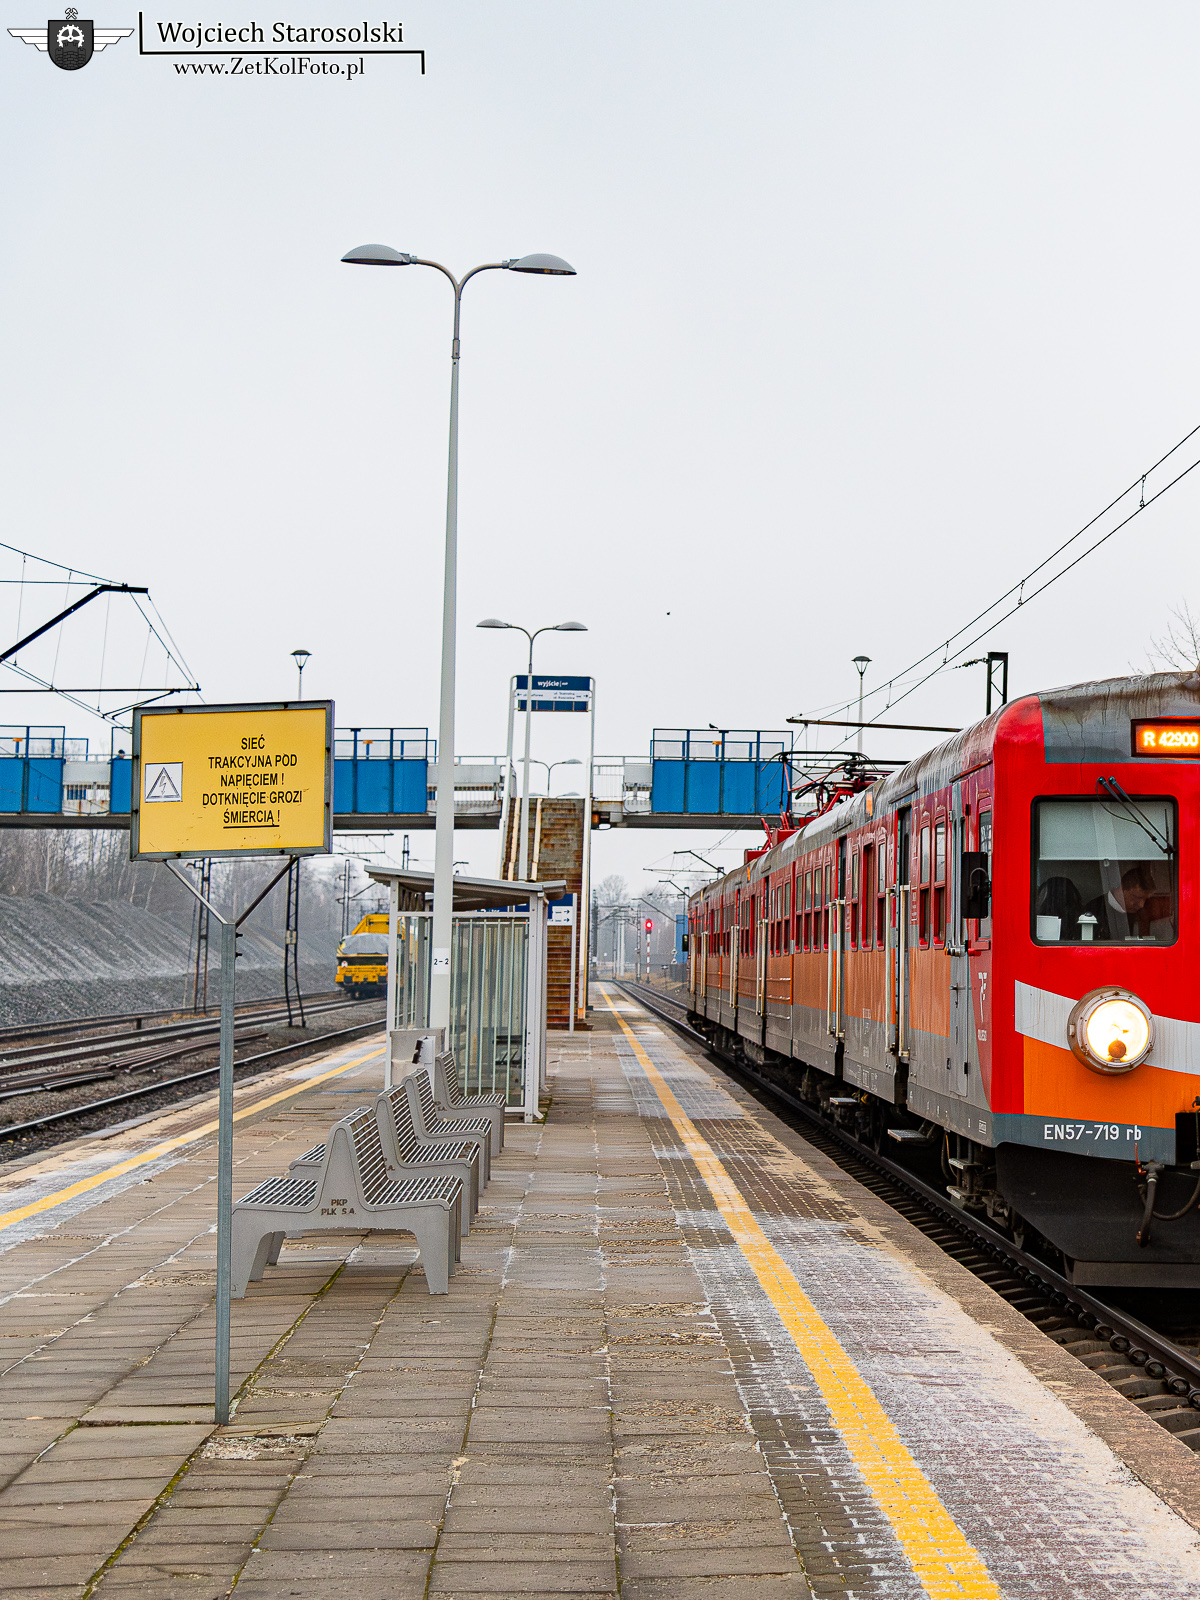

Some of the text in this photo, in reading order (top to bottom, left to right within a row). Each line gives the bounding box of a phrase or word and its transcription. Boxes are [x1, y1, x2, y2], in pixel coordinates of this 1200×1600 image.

[240, 734, 266, 750] SIEĆ
[1143, 731, 1156, 747] R
[1158, 731, 1199, 748] 42900
[208, 753, 298, 769] TRAKCYJNA POD
[220, 773, 285, 789] NAPIĘCIEM !
[202, 791, 303, 808] DOTKNIĘCIE GROZI
[223, 808, 281, 826] ŚMIERCIĄ !
[1043, 1124, 1142, 1141] EN57-719 rb
[330, 1198, 348, 1207] PKP
[321, 1207, 338, 1216] PLK
